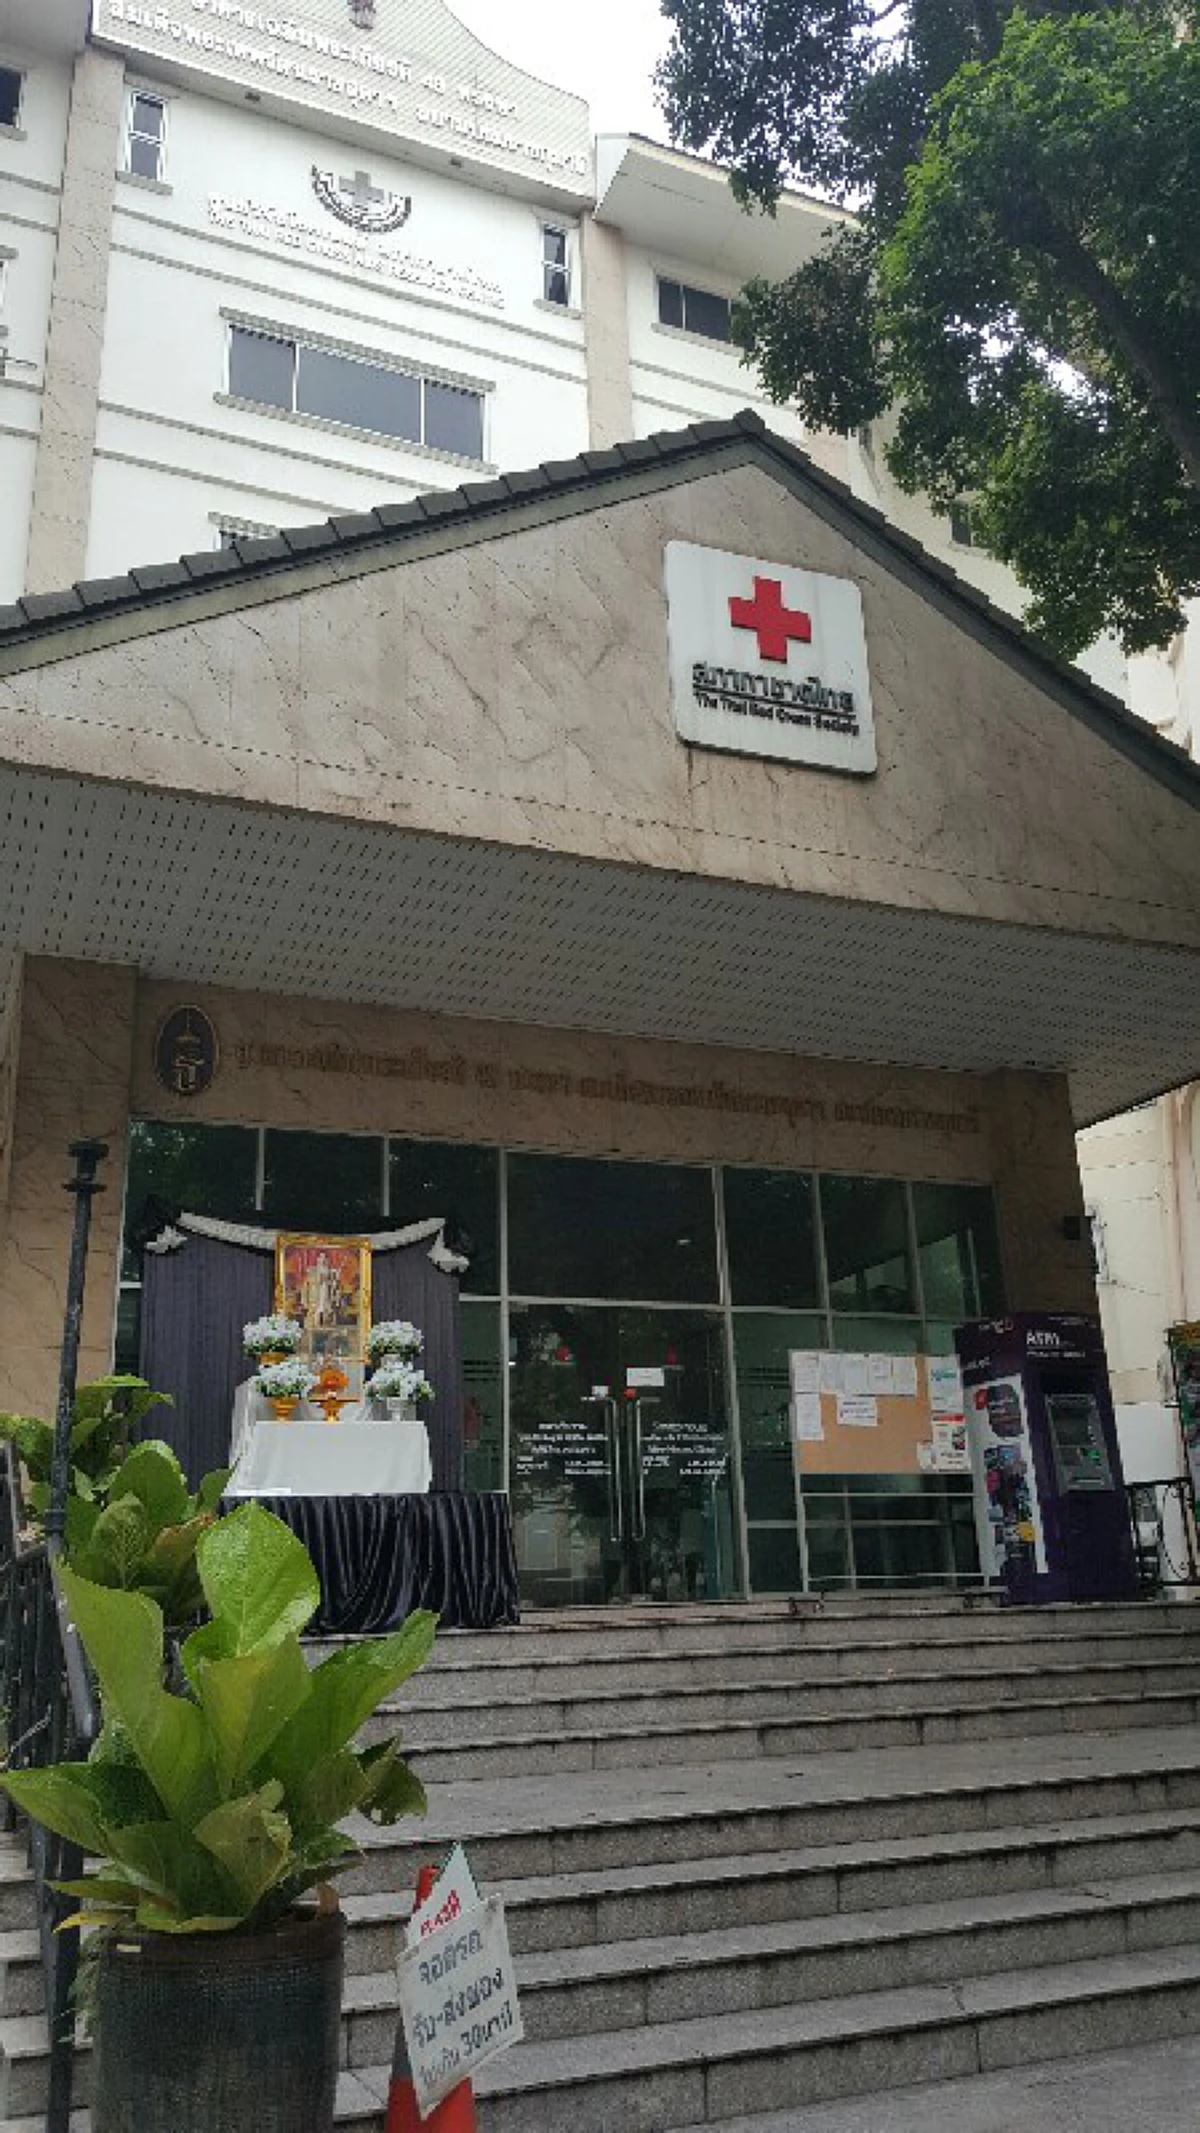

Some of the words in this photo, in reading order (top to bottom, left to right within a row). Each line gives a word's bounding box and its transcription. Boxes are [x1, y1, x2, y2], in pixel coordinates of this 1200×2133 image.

[692, 661, 854, 712] สภากาชาดไทย
[693, 692, 718, 709] The
[719, 696, 747, 716] Thai
[749, 703, 774, 721] Red
[775, 707, 812, 727] Cross
[813, 713, 860, 737] Society
[1026, 1330, 1060, 1346] ATM
